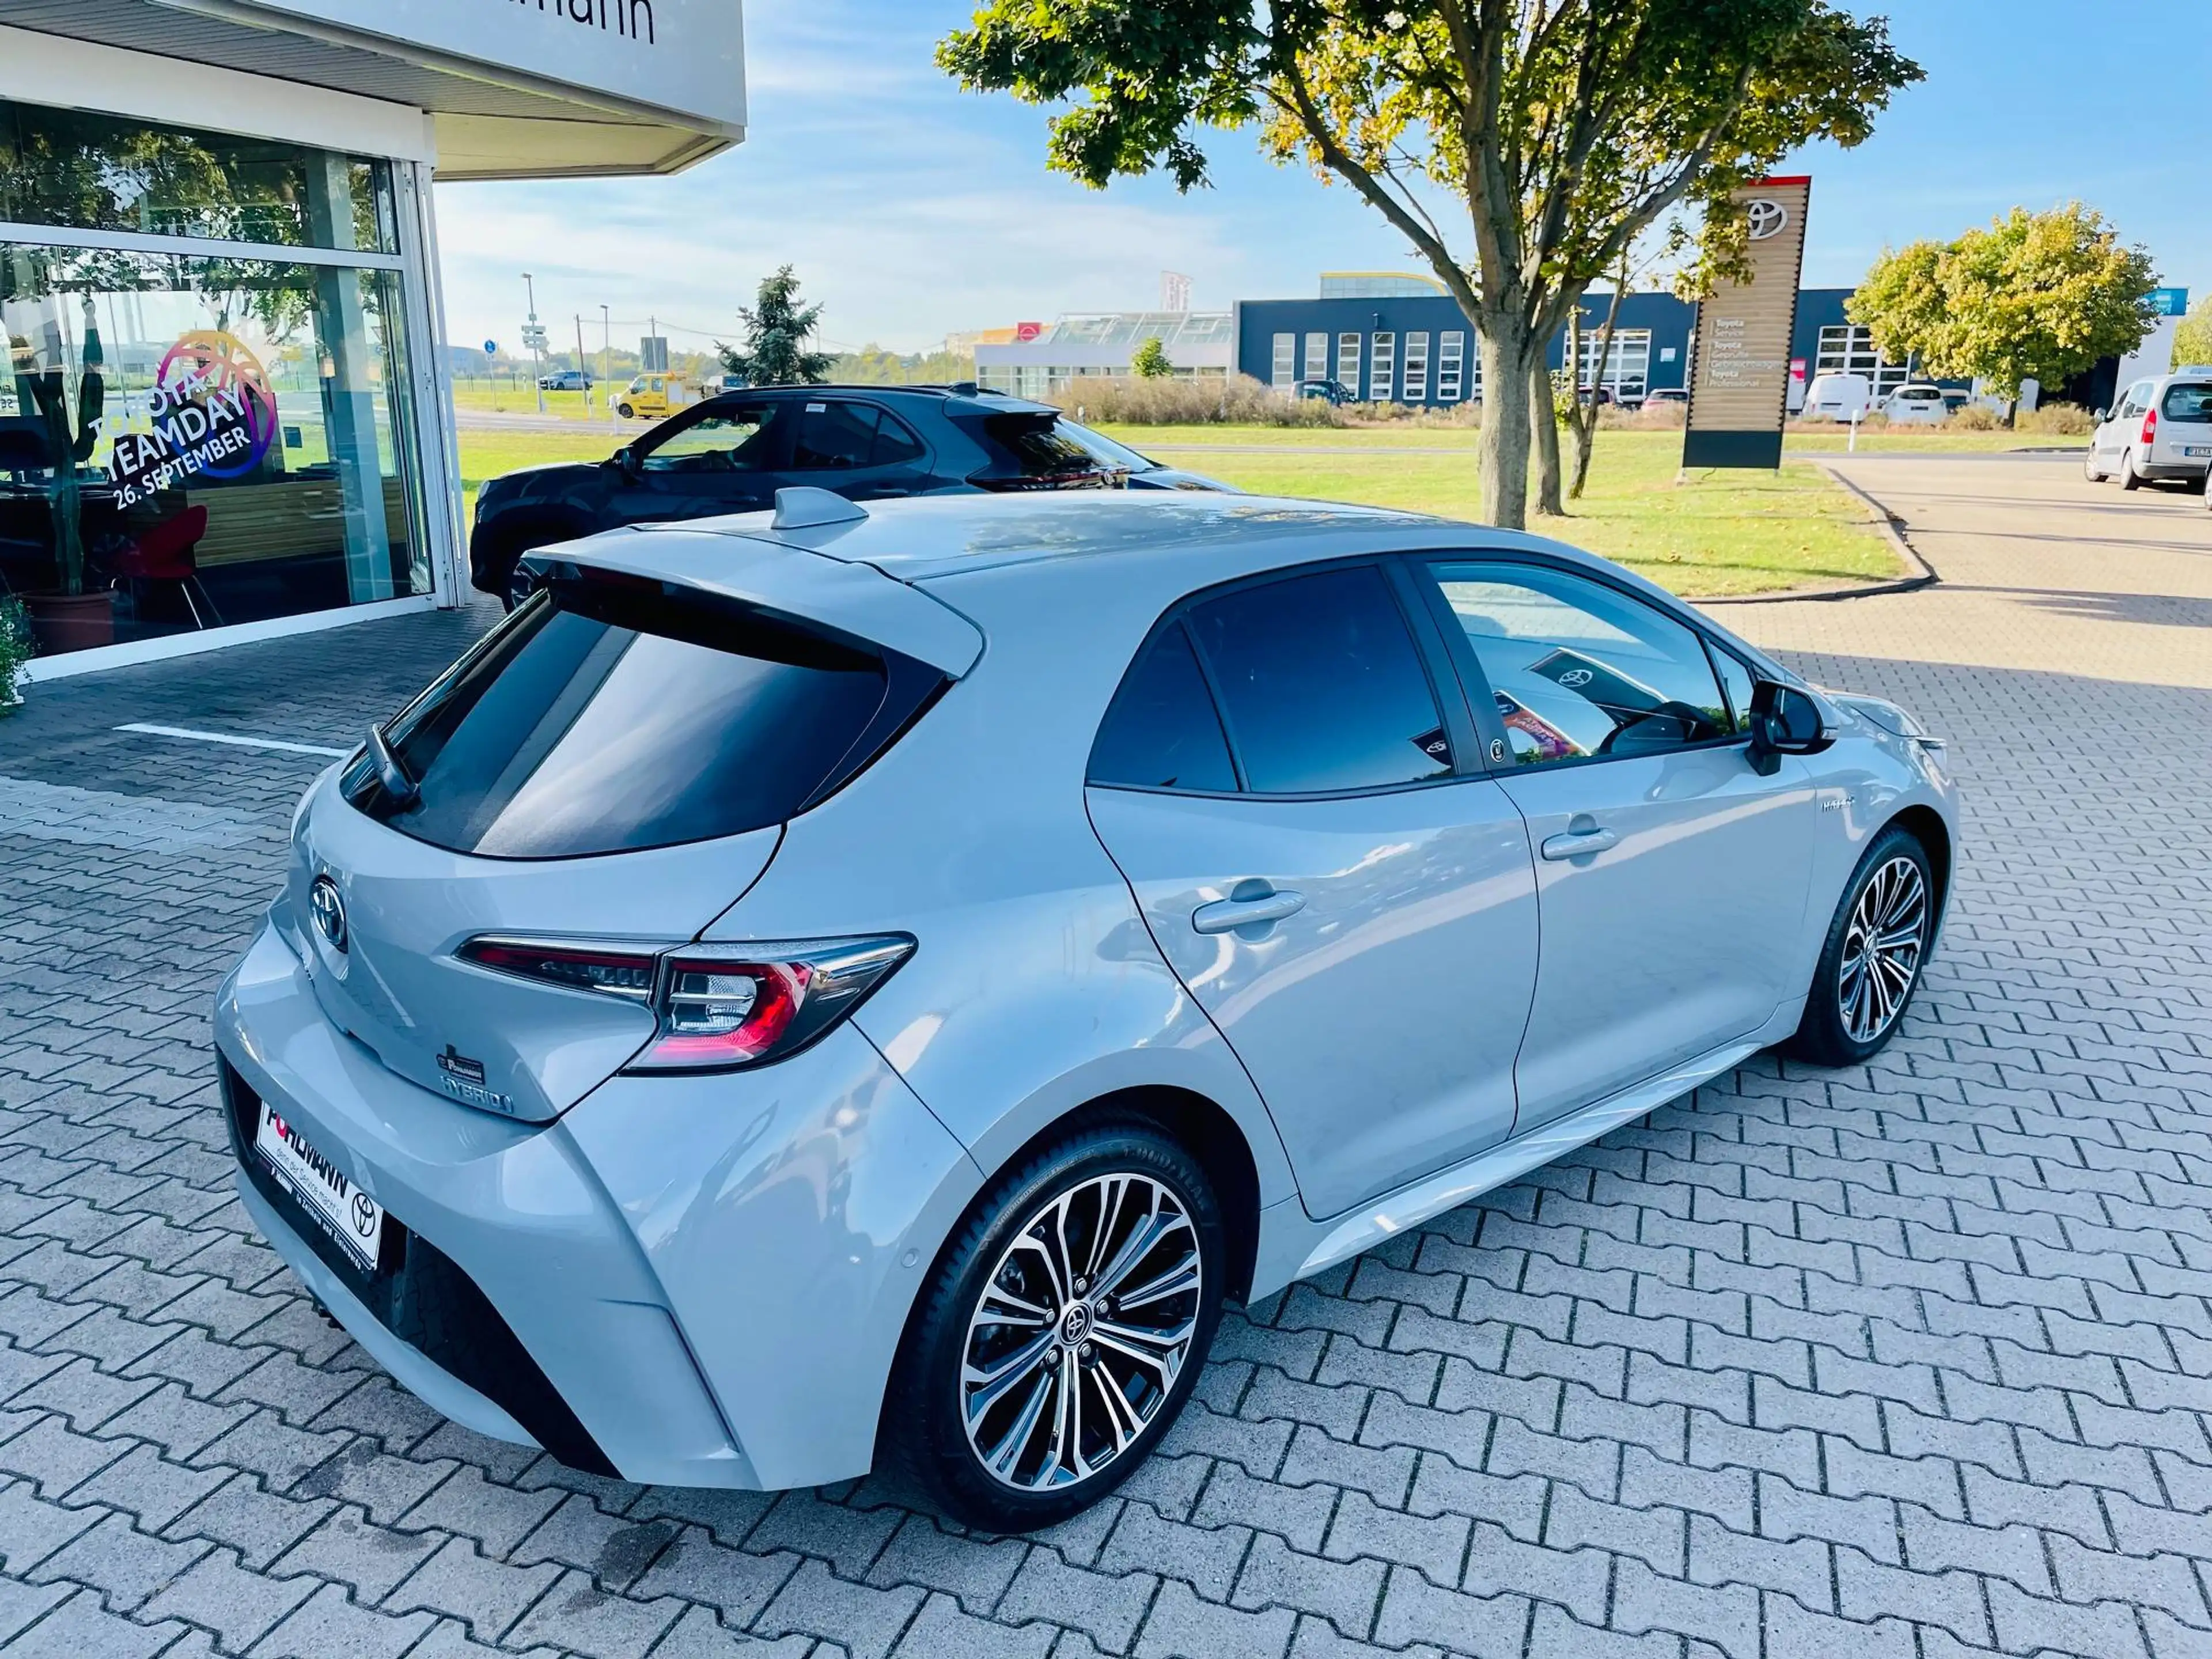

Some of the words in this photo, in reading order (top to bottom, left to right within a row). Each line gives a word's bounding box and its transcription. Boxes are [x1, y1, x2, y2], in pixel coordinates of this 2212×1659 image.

[1717, 319, 1744, 328] Toyota
[1713, 341, 1741, 350] Toyota
[1711, 369, 1739, 379] Toyota
[99, 381, 245, 482] TEAMDAY
[113, 484, 142, 510] 26.
[142, 426, 251, 495] SEPTEMBER
